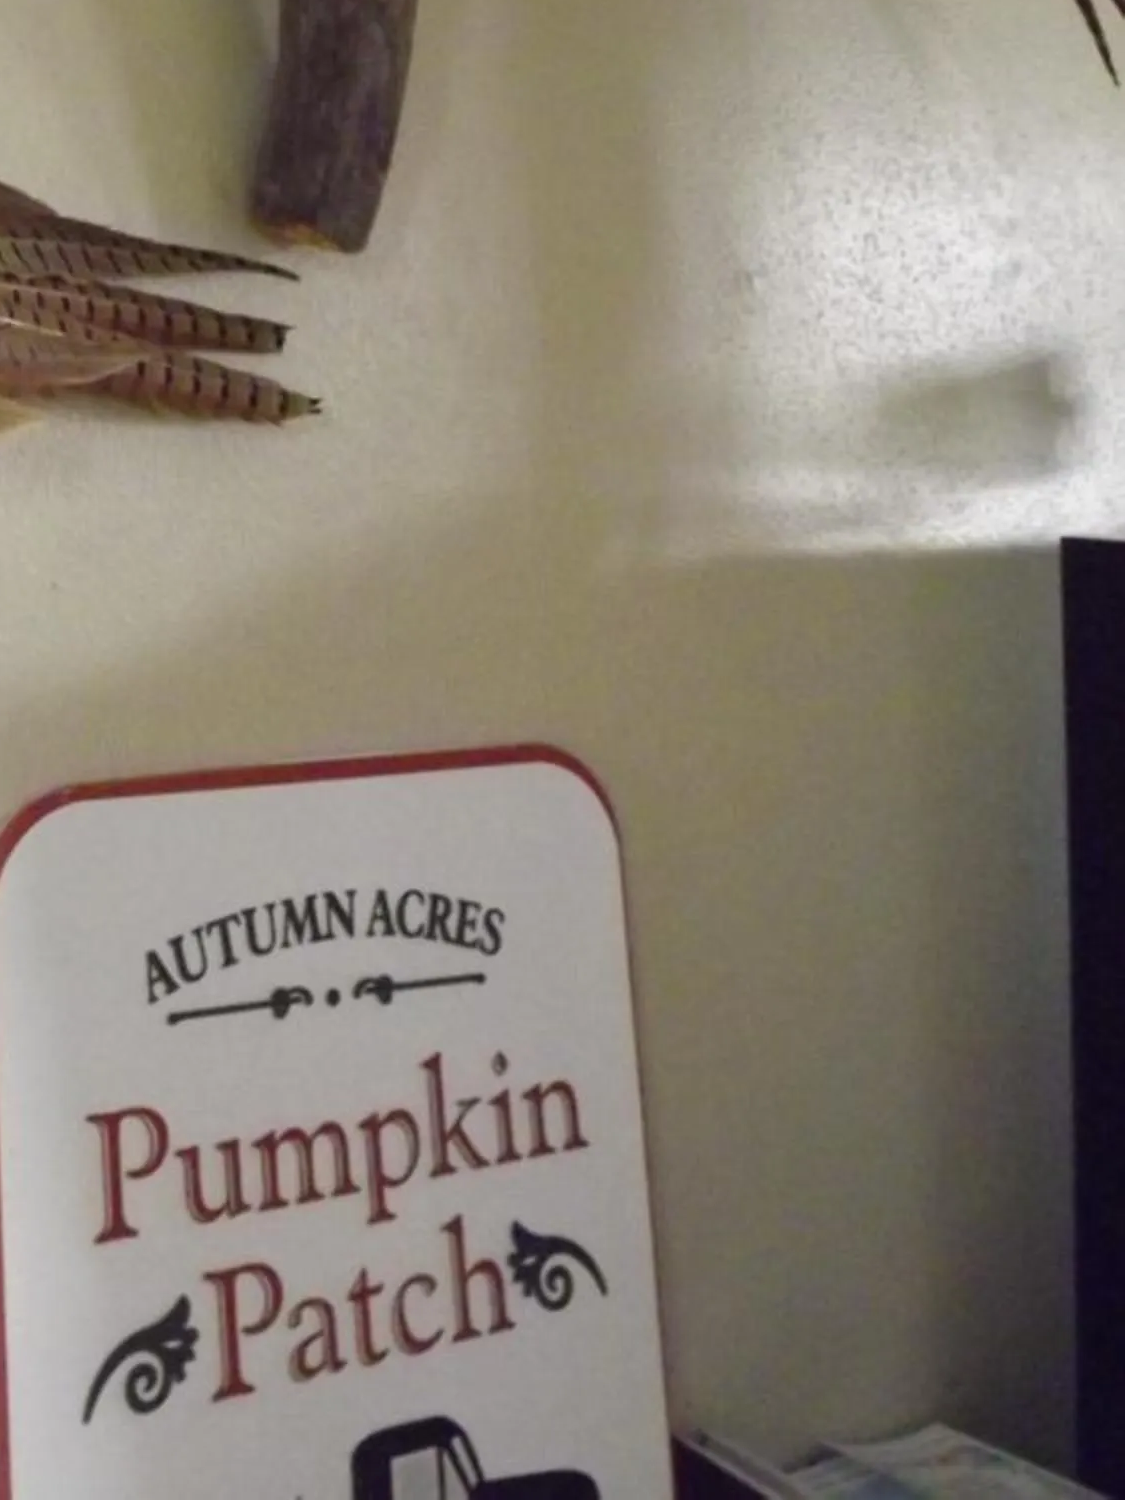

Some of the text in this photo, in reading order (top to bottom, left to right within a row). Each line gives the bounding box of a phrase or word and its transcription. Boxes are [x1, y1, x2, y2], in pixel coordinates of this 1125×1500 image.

[145, 888, 507, 1003] AUTUMN ACRES
[86, 1051, 590, 1245] Pumpkin
[203, 1214, 516, 1402] Patch
